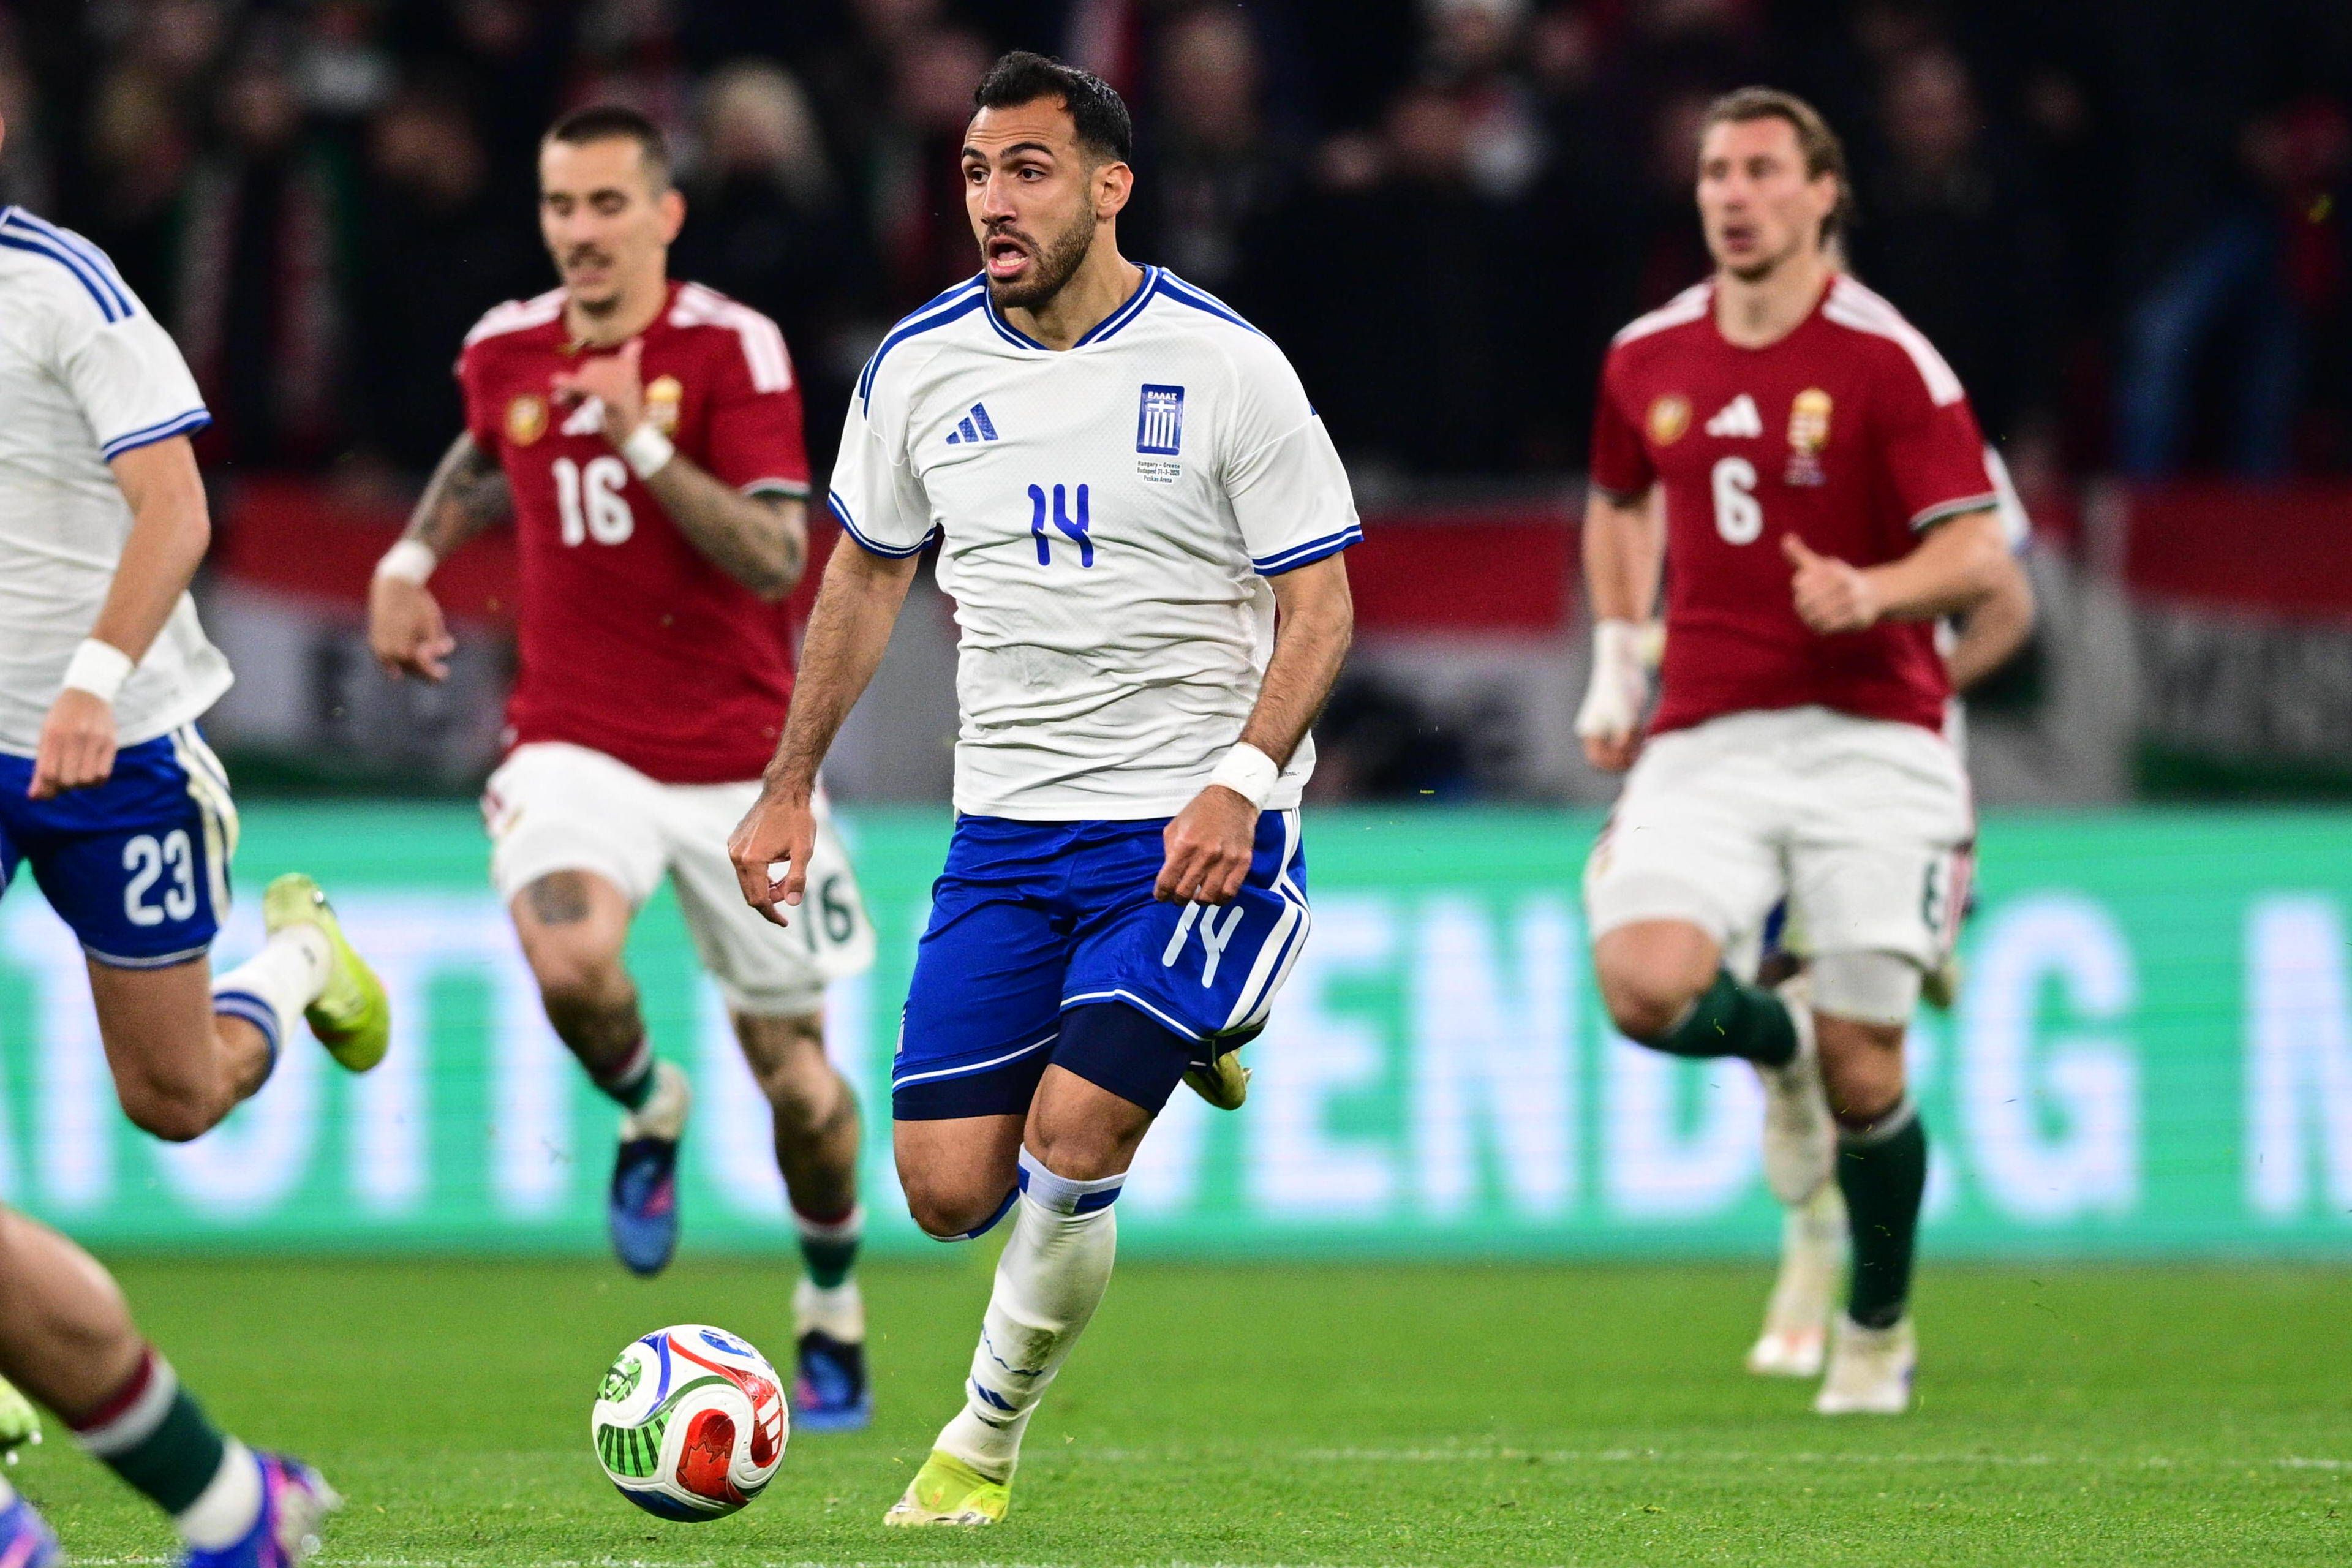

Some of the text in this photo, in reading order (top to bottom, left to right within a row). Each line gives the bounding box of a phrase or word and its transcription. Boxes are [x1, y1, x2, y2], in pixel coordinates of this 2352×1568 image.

[1148, 391, 1177, 401] ΕΛΛΑΣ
[552, 455, 635, 547] 16
[1138, 460, 1158, 469] Hungary
[1711, 455, 1763, 546] 6
[1028, 483, 1094, 568] 14
[122, 829, 197, 927] 23
[801, 873, 854, 951] 16
[1162, 886, 1244, 989] 14
